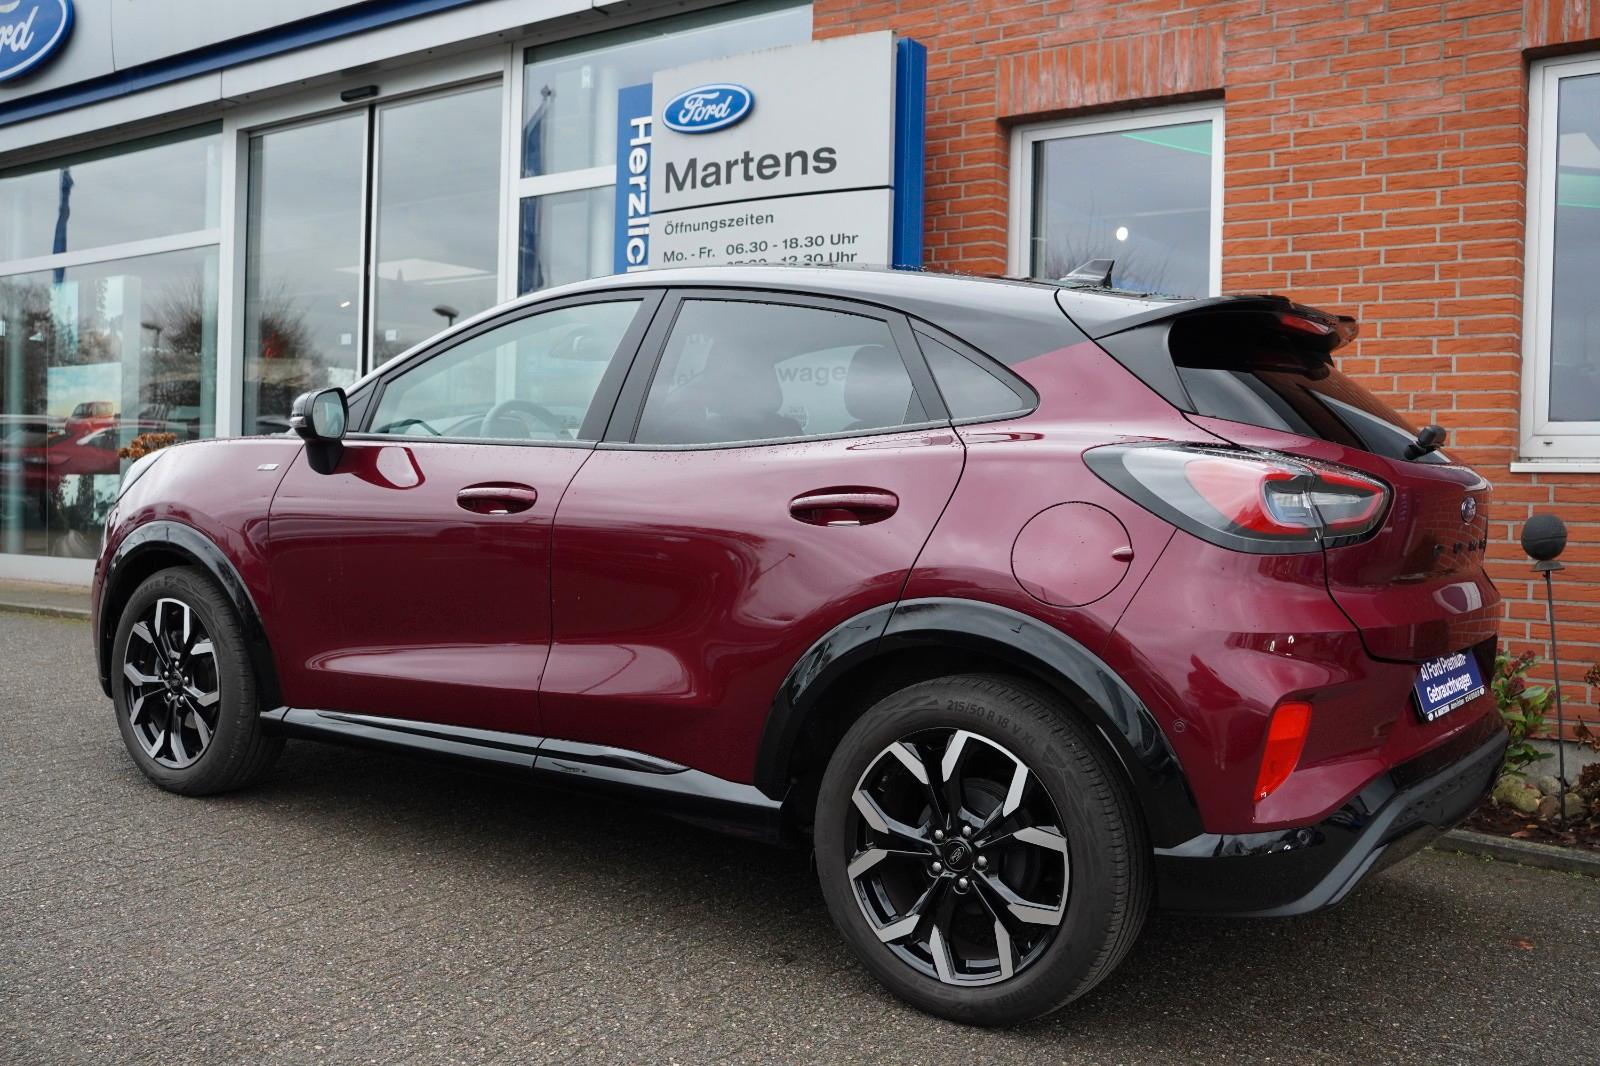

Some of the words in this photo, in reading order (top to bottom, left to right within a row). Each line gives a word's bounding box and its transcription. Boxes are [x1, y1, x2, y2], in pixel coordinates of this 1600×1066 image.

[0, 0, 39, 53] rd
[679, 91, 733, 126] Ford
[665, 146, 837, 193] Martens
[664, 213, 774, 236] Öffnungszeiten
[663, 249, 687, 263] Mo.
[699, 246, 715, 259] Fr.
[726, 241, 768, 256] 06.30
[782, 235, 825, 250] 18.30
[830, 232, 859, 246] Uhr
[829, 251, 858, 263] Uhr
[1426, 658, 1444, 679] Ford
[1426, 673, 1473, 704] Gebrauchtwagen
[947, 700, 985, 718] 215/50
[986, 710, 996, 721] R
[997, 715, 1010, 729] 18
